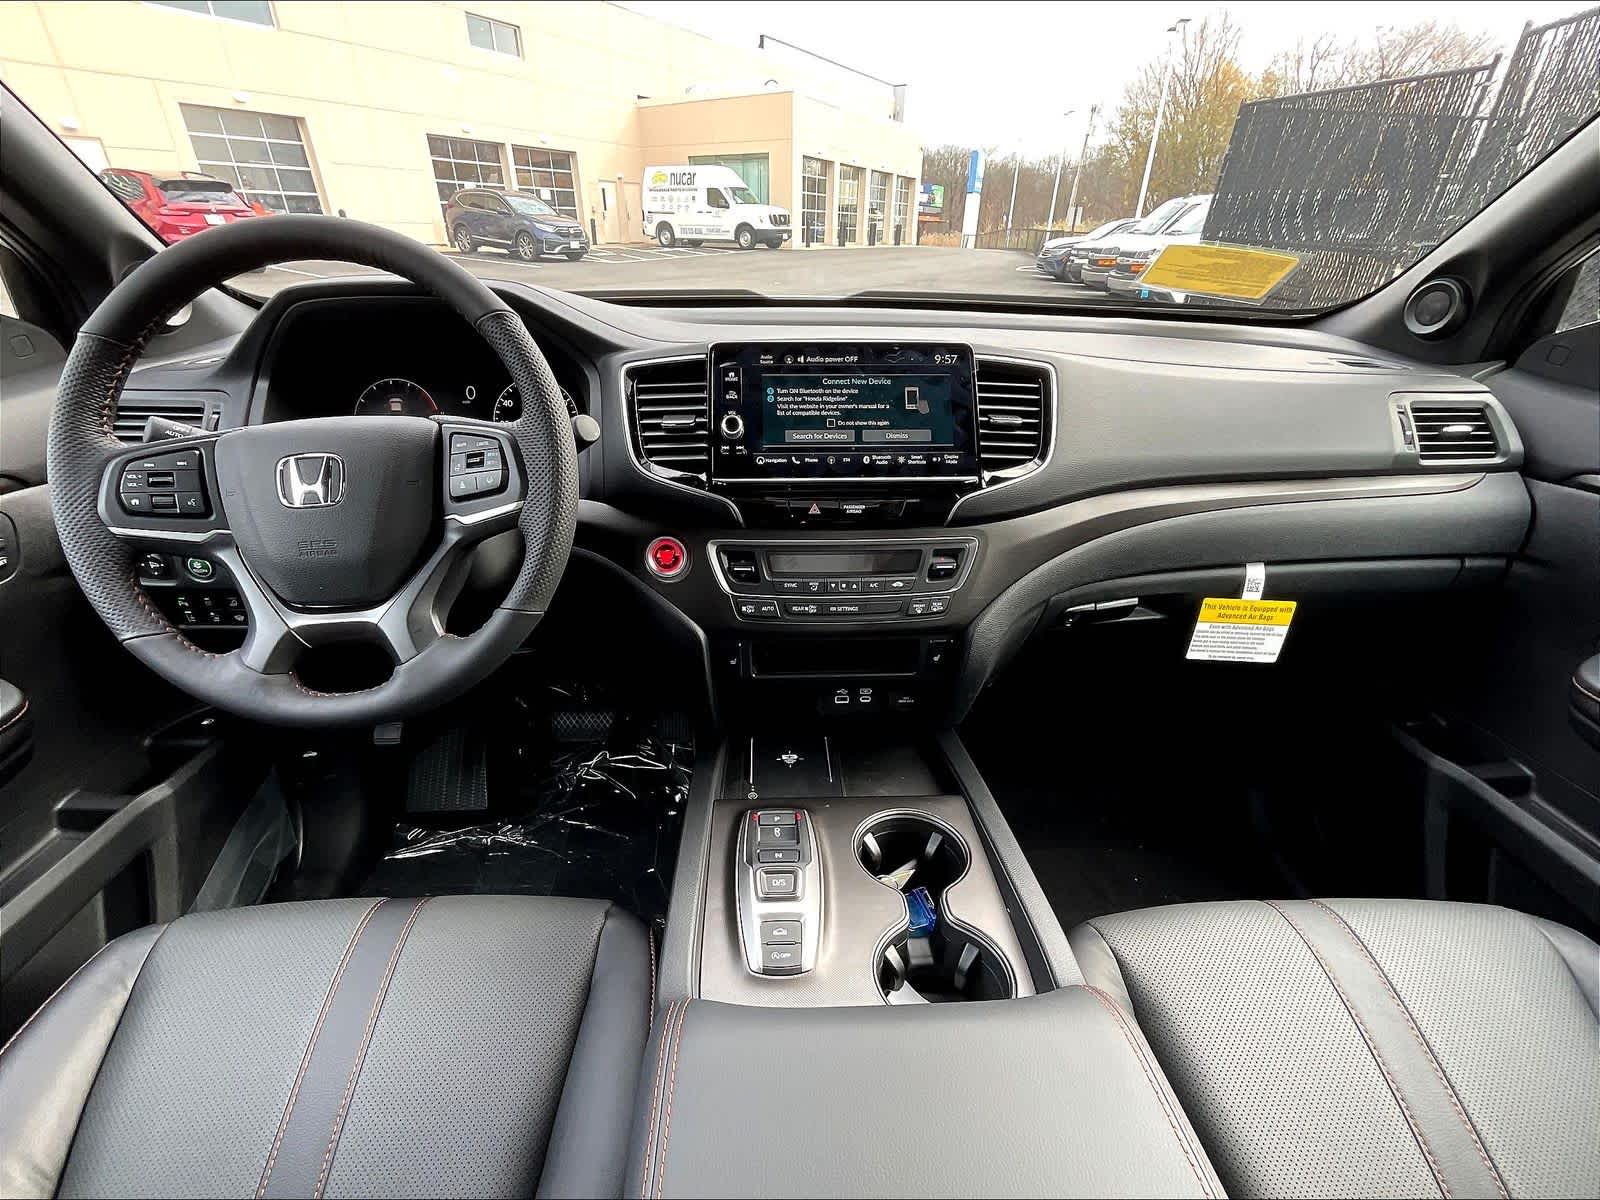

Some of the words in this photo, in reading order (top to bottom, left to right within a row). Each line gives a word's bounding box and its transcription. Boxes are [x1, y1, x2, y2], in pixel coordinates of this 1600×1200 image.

[670, 172, 696, 186] nucar
[934, 354, 958, 364] 9:57
[466, 386, 476, 400] 0
[164, 430, 184, 439] AUTO
[1250, 605, 1278, 613] Equipped
